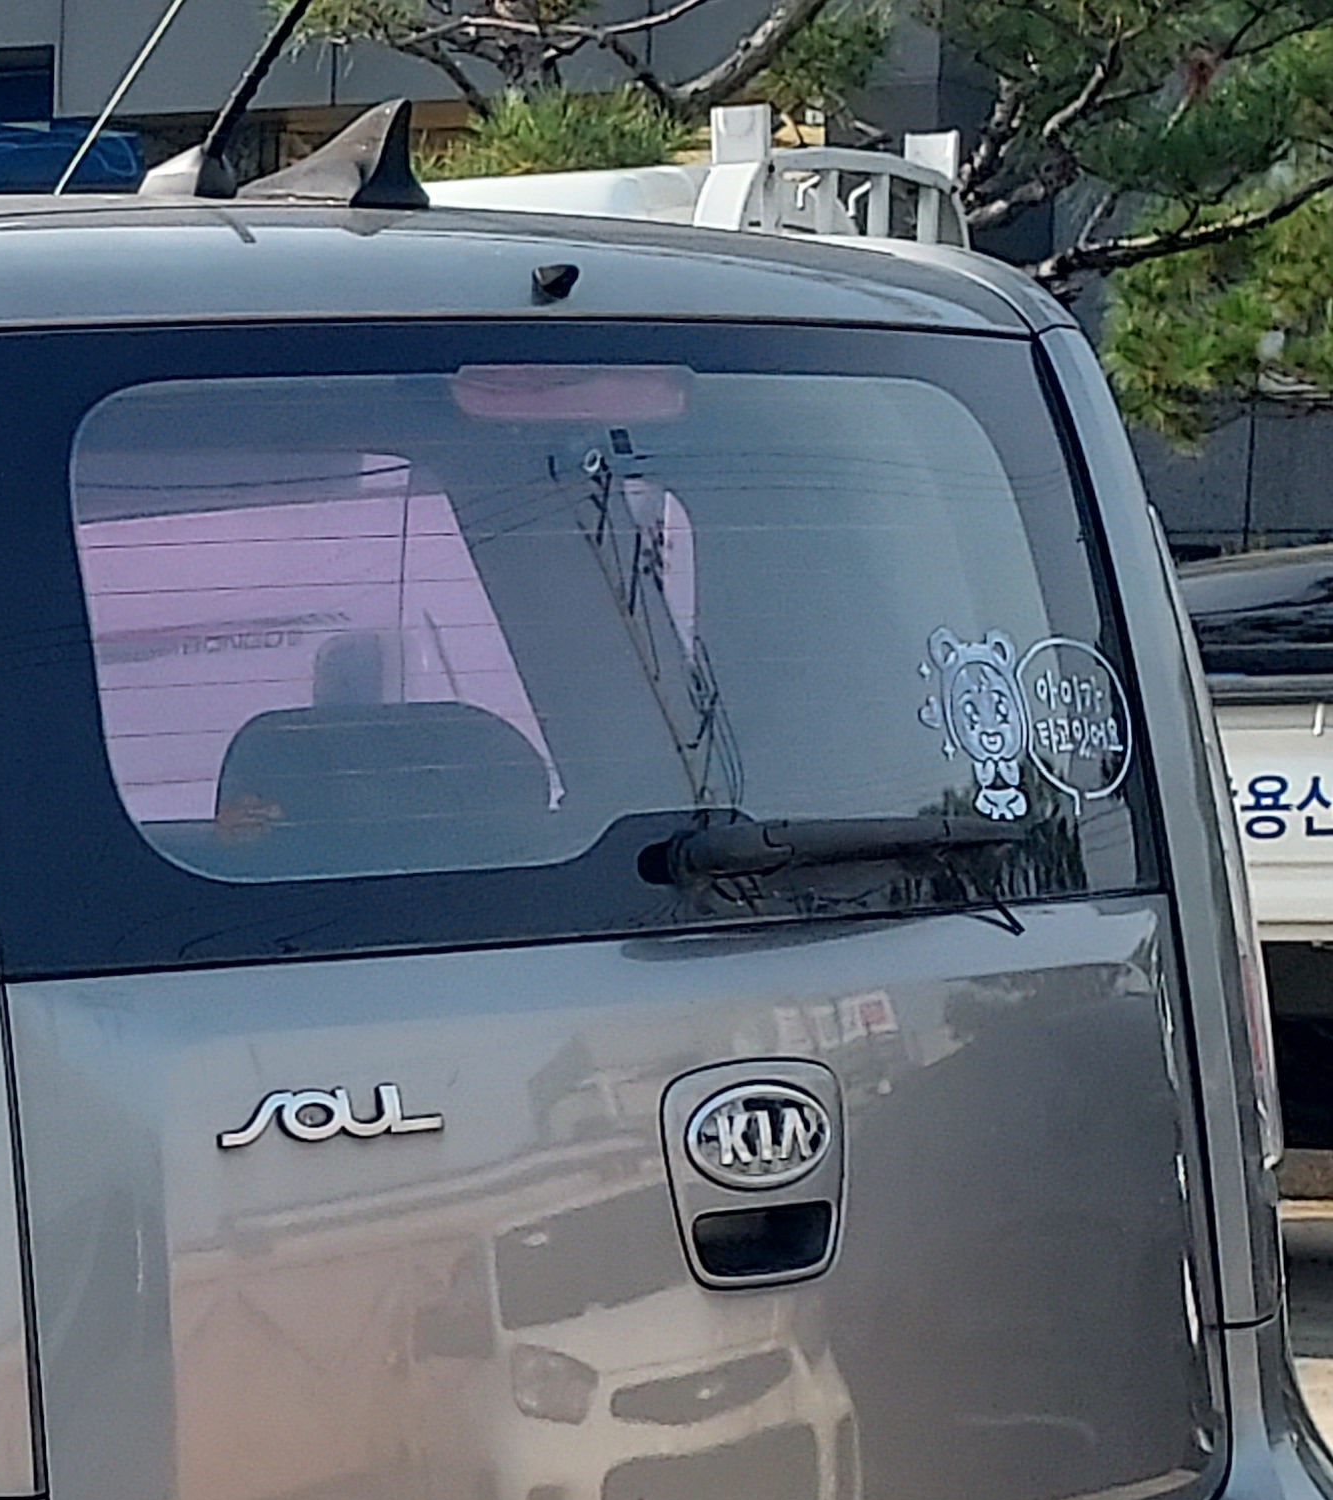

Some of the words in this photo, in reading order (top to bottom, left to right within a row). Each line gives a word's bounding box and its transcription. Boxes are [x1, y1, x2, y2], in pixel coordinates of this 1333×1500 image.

[1036, 669, 1103, 713] 아이가
[1231, 775, 1333, 839] 용산
[217, 1082, 444, 1149] SOUL
